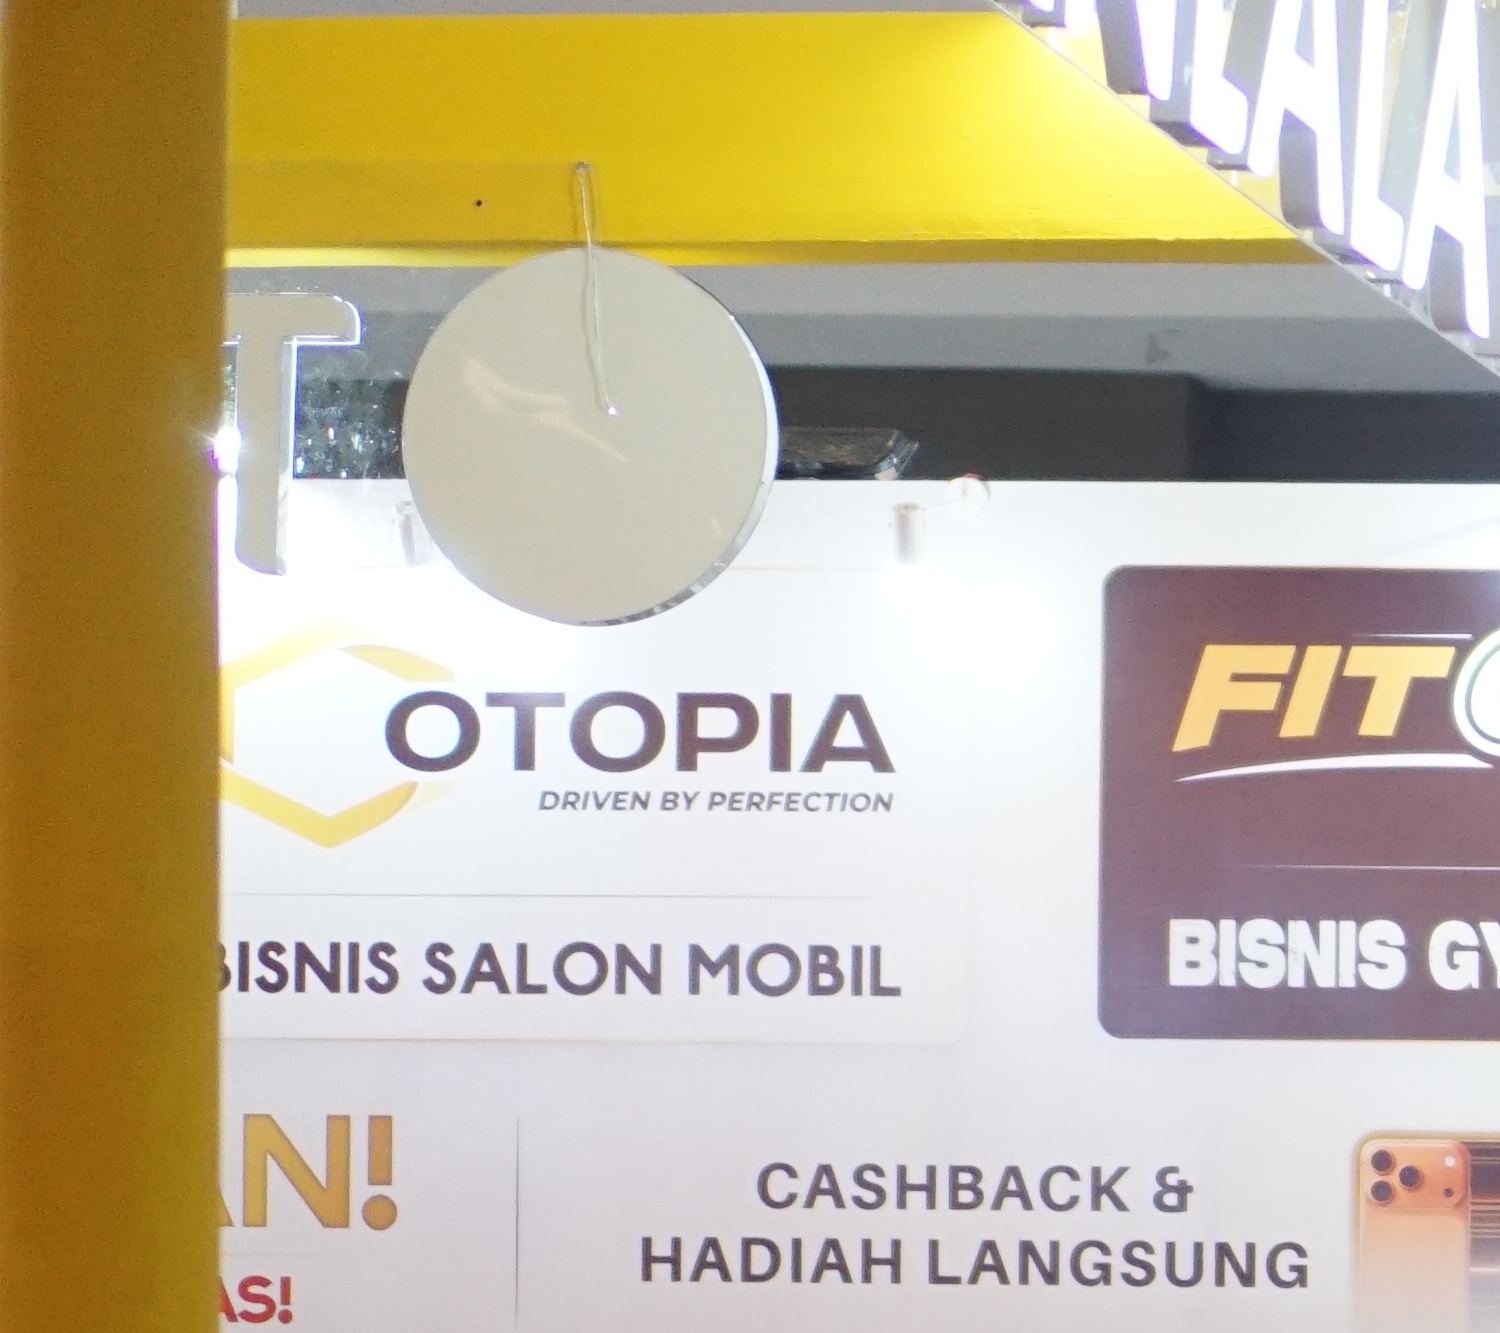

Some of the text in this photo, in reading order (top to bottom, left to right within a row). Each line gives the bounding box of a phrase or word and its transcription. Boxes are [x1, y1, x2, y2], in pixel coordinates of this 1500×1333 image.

[385, 690, 896, 774] OTOPIA
[539, 790, 894, 813] DRIVEN BY PERFECTION
[423, 942, 663, 997] SALON
[687, 943, 902, 997] MOBIL
[1168, 918, 1405, 991] BISNIS
[757, 1162, 1193, 1213] CASHBACK &
[640, 1236, 1310, 1289] HADIAH LANGSUNG
